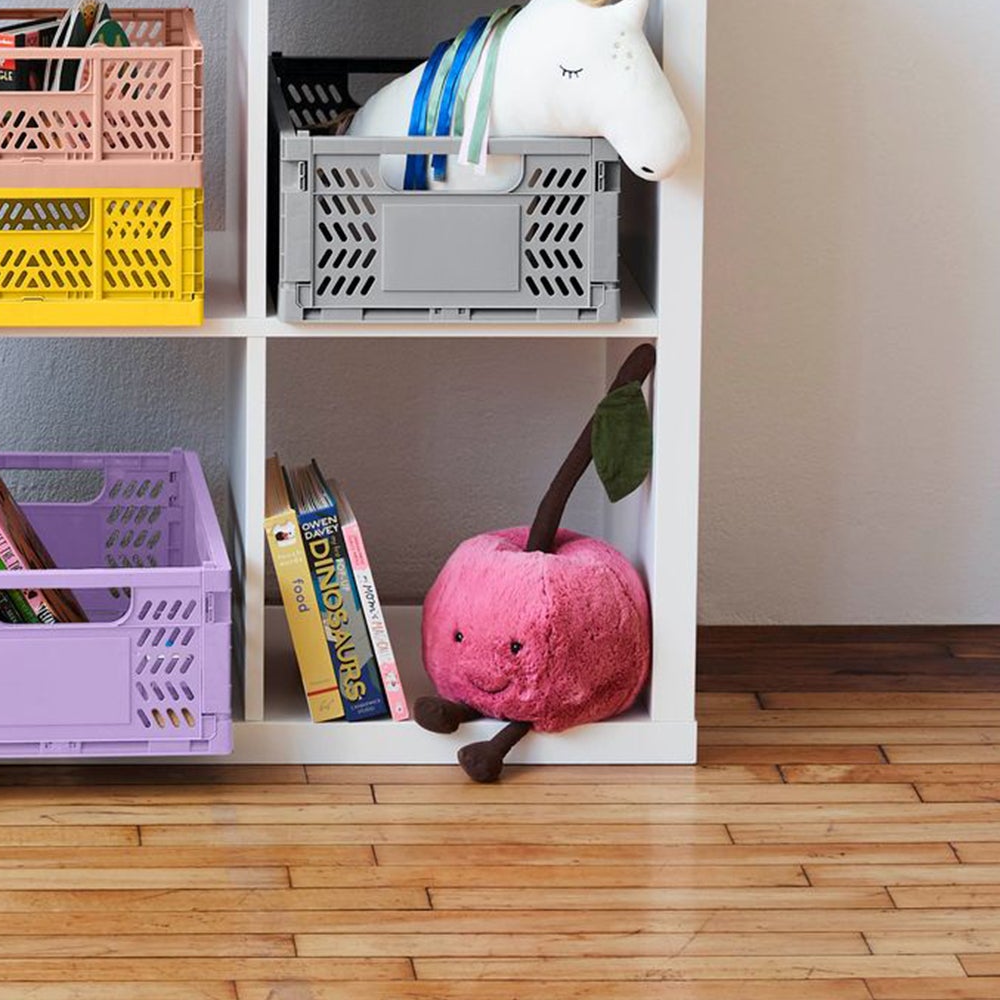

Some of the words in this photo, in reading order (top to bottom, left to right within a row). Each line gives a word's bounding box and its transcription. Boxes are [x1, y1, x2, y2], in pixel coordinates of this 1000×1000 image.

[301, 515, 338, 532] OWEN
[304, 524, 339, 540] DAVEY
[293, 579, 309, 612] food
[309, 538, 366, 702] DINOSAURS
